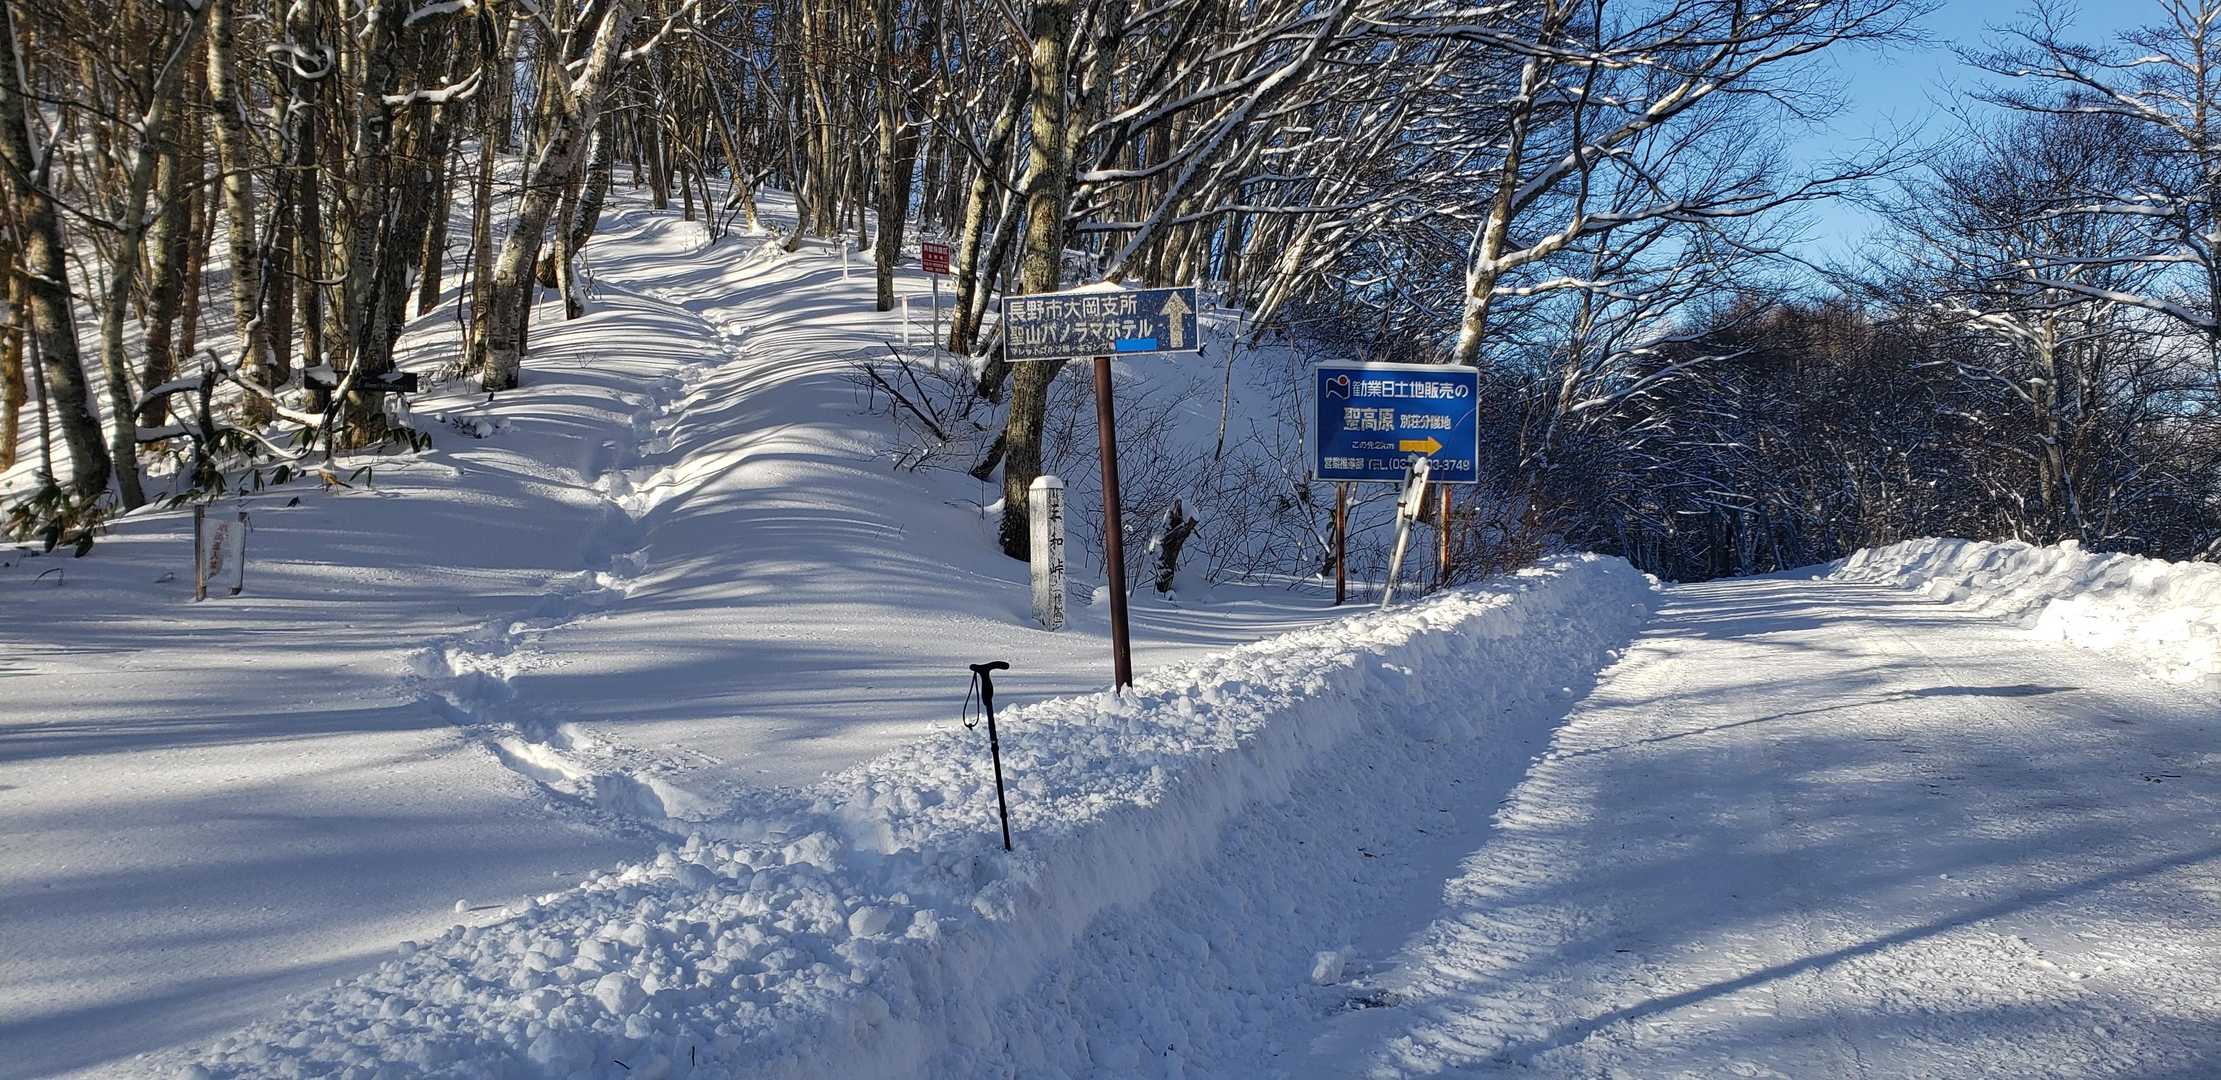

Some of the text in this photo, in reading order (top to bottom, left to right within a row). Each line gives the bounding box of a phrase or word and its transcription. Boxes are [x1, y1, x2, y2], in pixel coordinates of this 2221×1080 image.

[1008, 294, 1138, 322] 長野市大岡支所
[1008, 318, 1153, 346] 聖山パノラマホテル
[1352, 380, 1469, 400] 勧業日土地販売の
[1343, 407, 1452, 432] 聖高原 別荘分譲地
